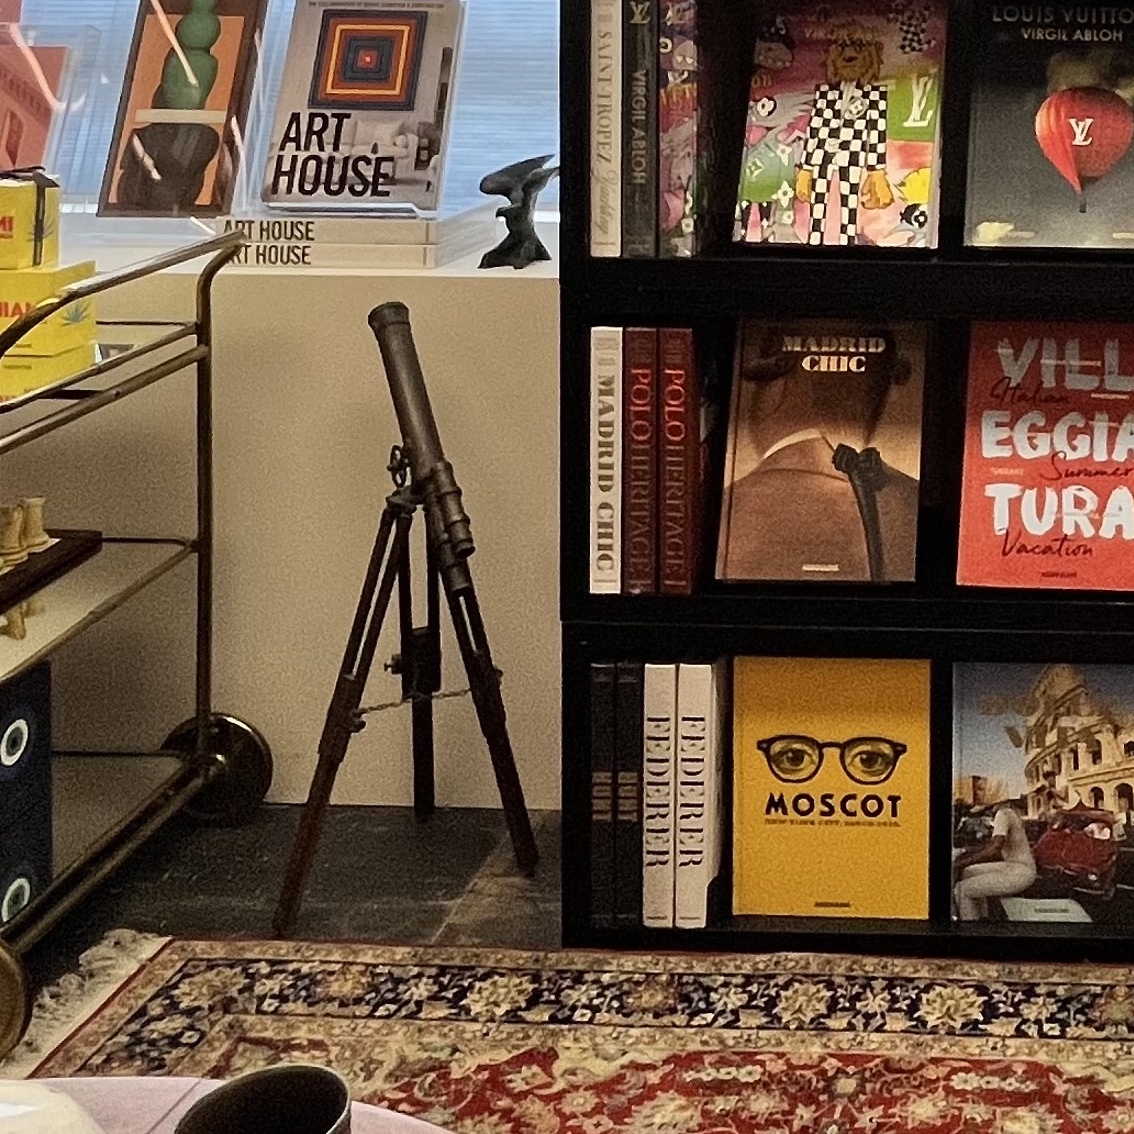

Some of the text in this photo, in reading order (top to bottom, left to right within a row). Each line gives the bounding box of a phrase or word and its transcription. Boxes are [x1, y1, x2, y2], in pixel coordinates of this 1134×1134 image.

[992, 5, 1051, 23] LOUIS
[1021, 27, 1124, 42] VIRGIL ABLOH
[279, 112, 352, 153] ART
[630, 69, 647, 184] VIRGIL ABLOH
[270, 154, 395, 197] HOUSE
[260, 220, 315, 241] HOUSE
[255, 245, 311, 265] HOUSE
[801, 355, 867, 372] CHIC
[597, 375, 615, 493] MADRID
[629, 368, 651, 572] POLO HERITAGE
[665, 368, 685, 574] POLO HERITAGE
[597, 502, 615, 571] CHIC
[1001, 529, 1093, 558] Vacation
[645, 716, 671, 867] FEDERER
[679, 716, 706, 867] FEDERER
[765, 792, 902, 818] MOSCOT
